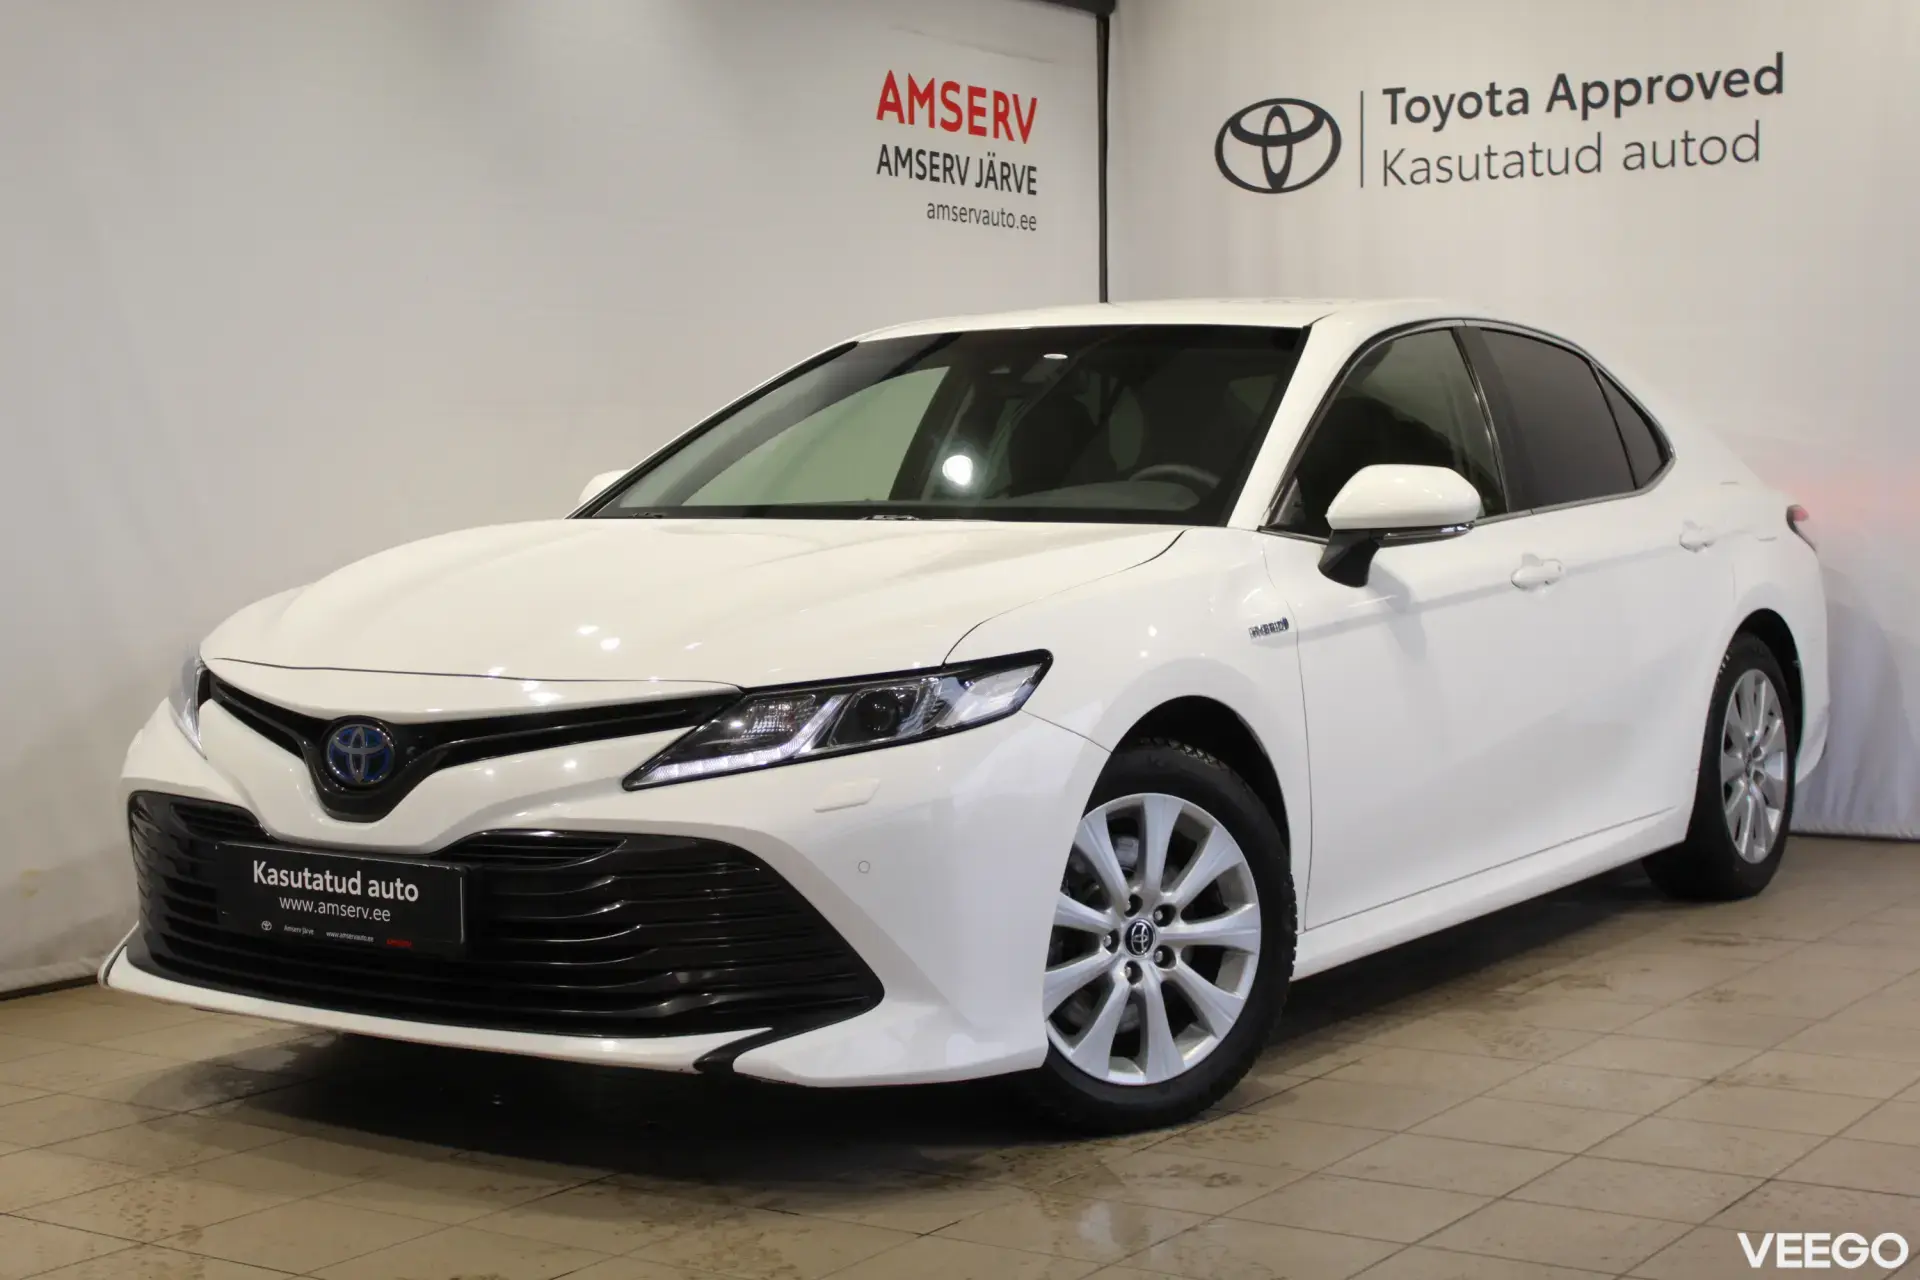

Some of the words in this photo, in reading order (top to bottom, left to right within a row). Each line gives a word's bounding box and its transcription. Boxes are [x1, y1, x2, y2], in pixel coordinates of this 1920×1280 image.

[876, 69, 1038, 145] AMSERV
[1382, 83, 1530, 132] Toyota
[1545, 51, 1785, 121] Approved
[876, 143, 970, 186] AMSERV
[975, 151, 1037, 196] JÄRVE
[1382, 132, 1603, 187] Kasutatud
[1622, 120, 1761, 172] autod
[926, 202, 1037, 231] amservauto.ee
[253, 860, 362, 896] Kasutatud
[367, 878, 419, 902] auto
[279, 897, 391, 922] www.amserv.ee
